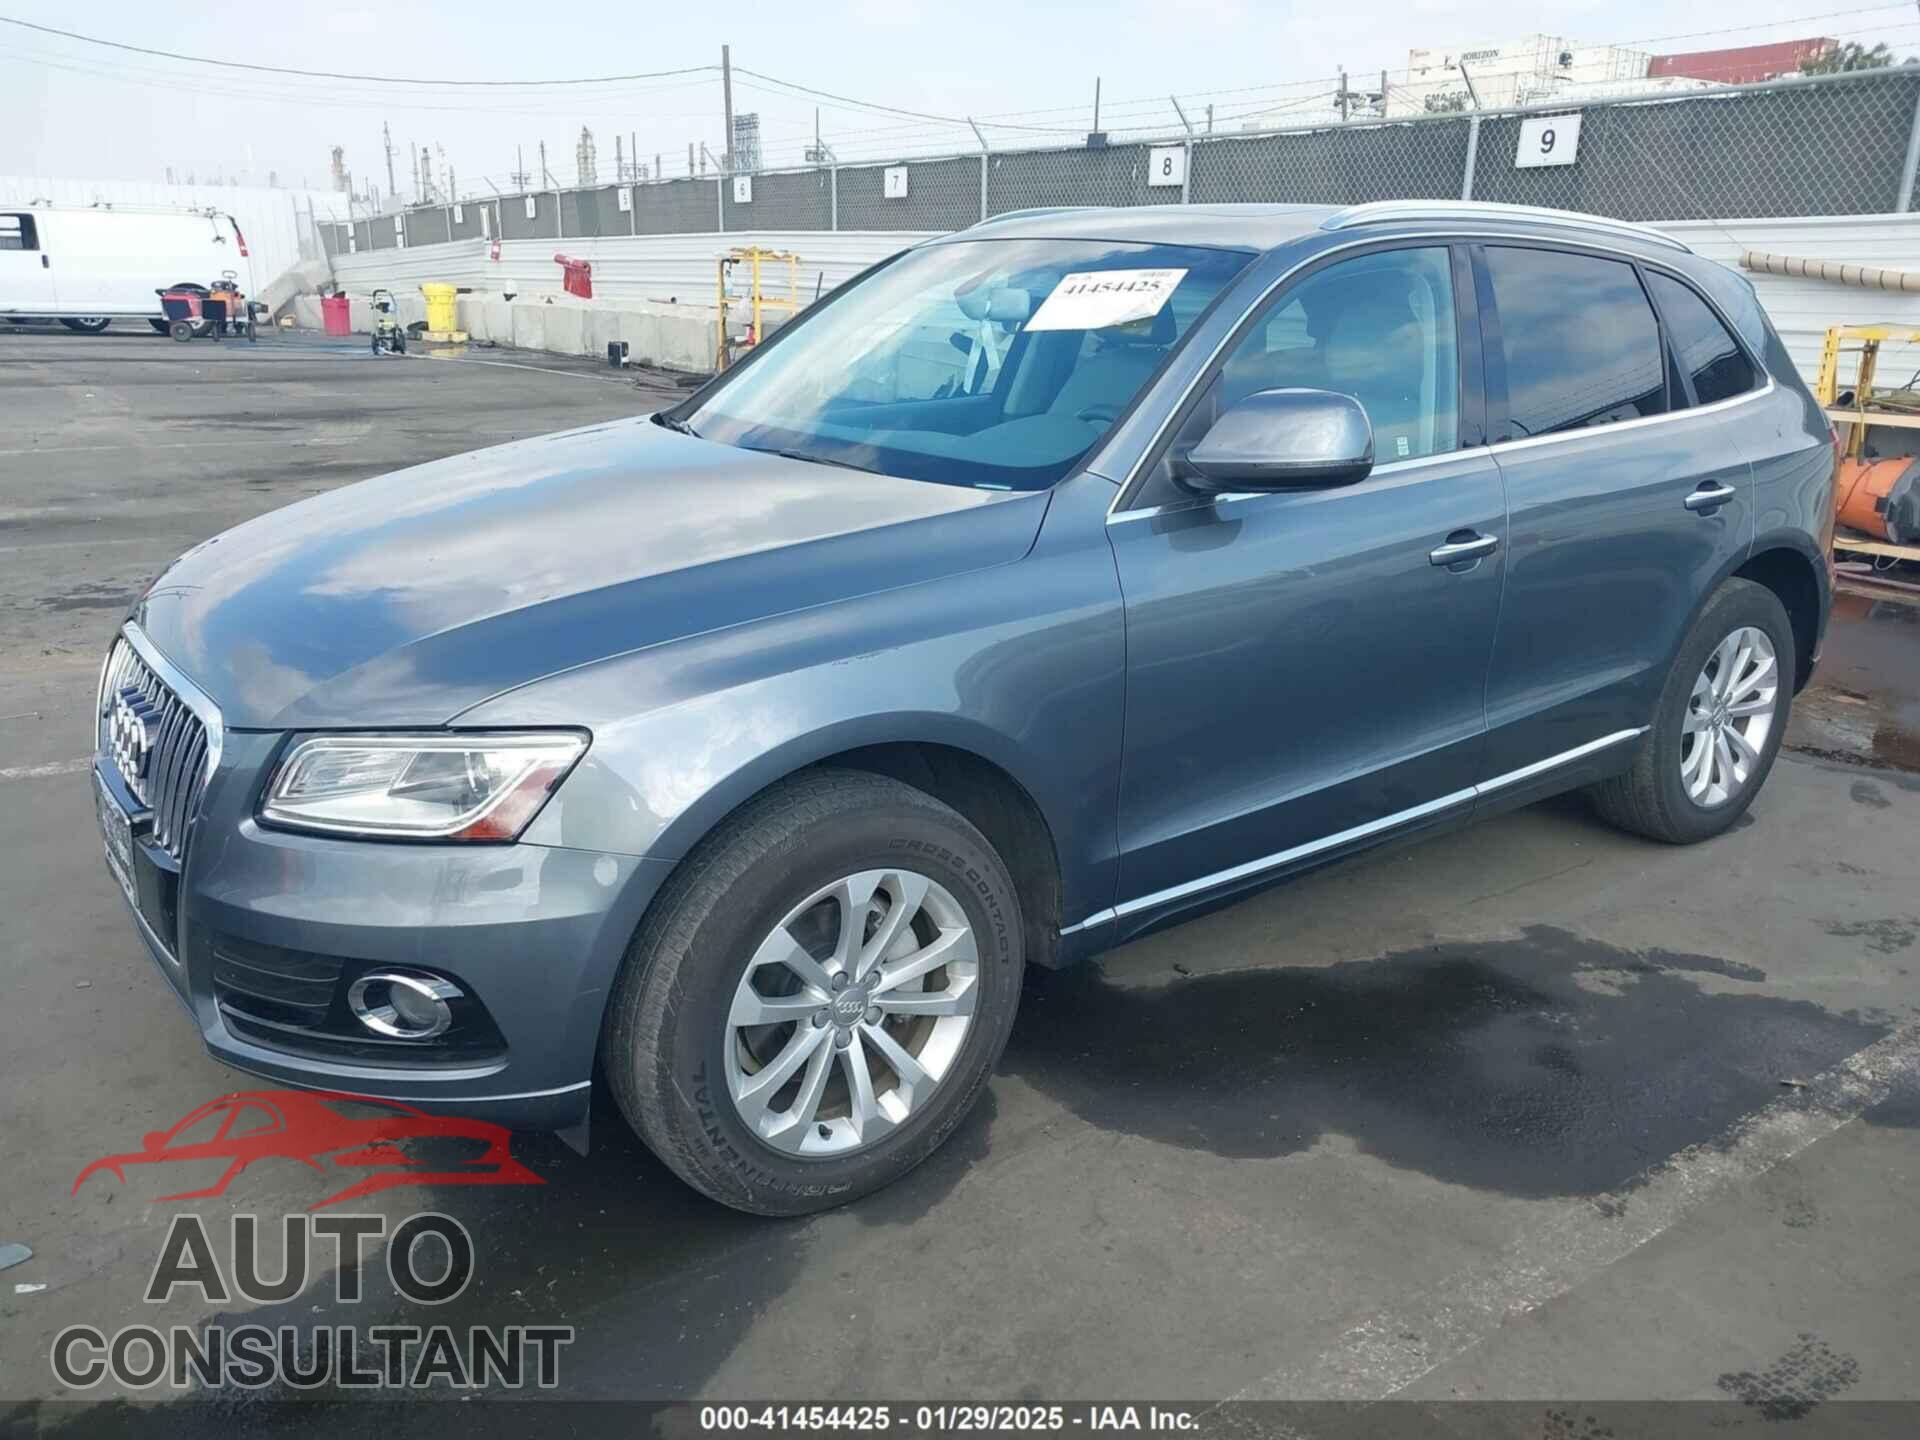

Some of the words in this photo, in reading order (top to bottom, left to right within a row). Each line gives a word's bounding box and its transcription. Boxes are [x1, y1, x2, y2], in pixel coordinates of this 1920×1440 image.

[1541, 129, 1556, 154] 9
[1163, 157, 1172, 176] 8
[892, 175, 900, 189] 7
[1063, 280, 1161, 296] 41454425
